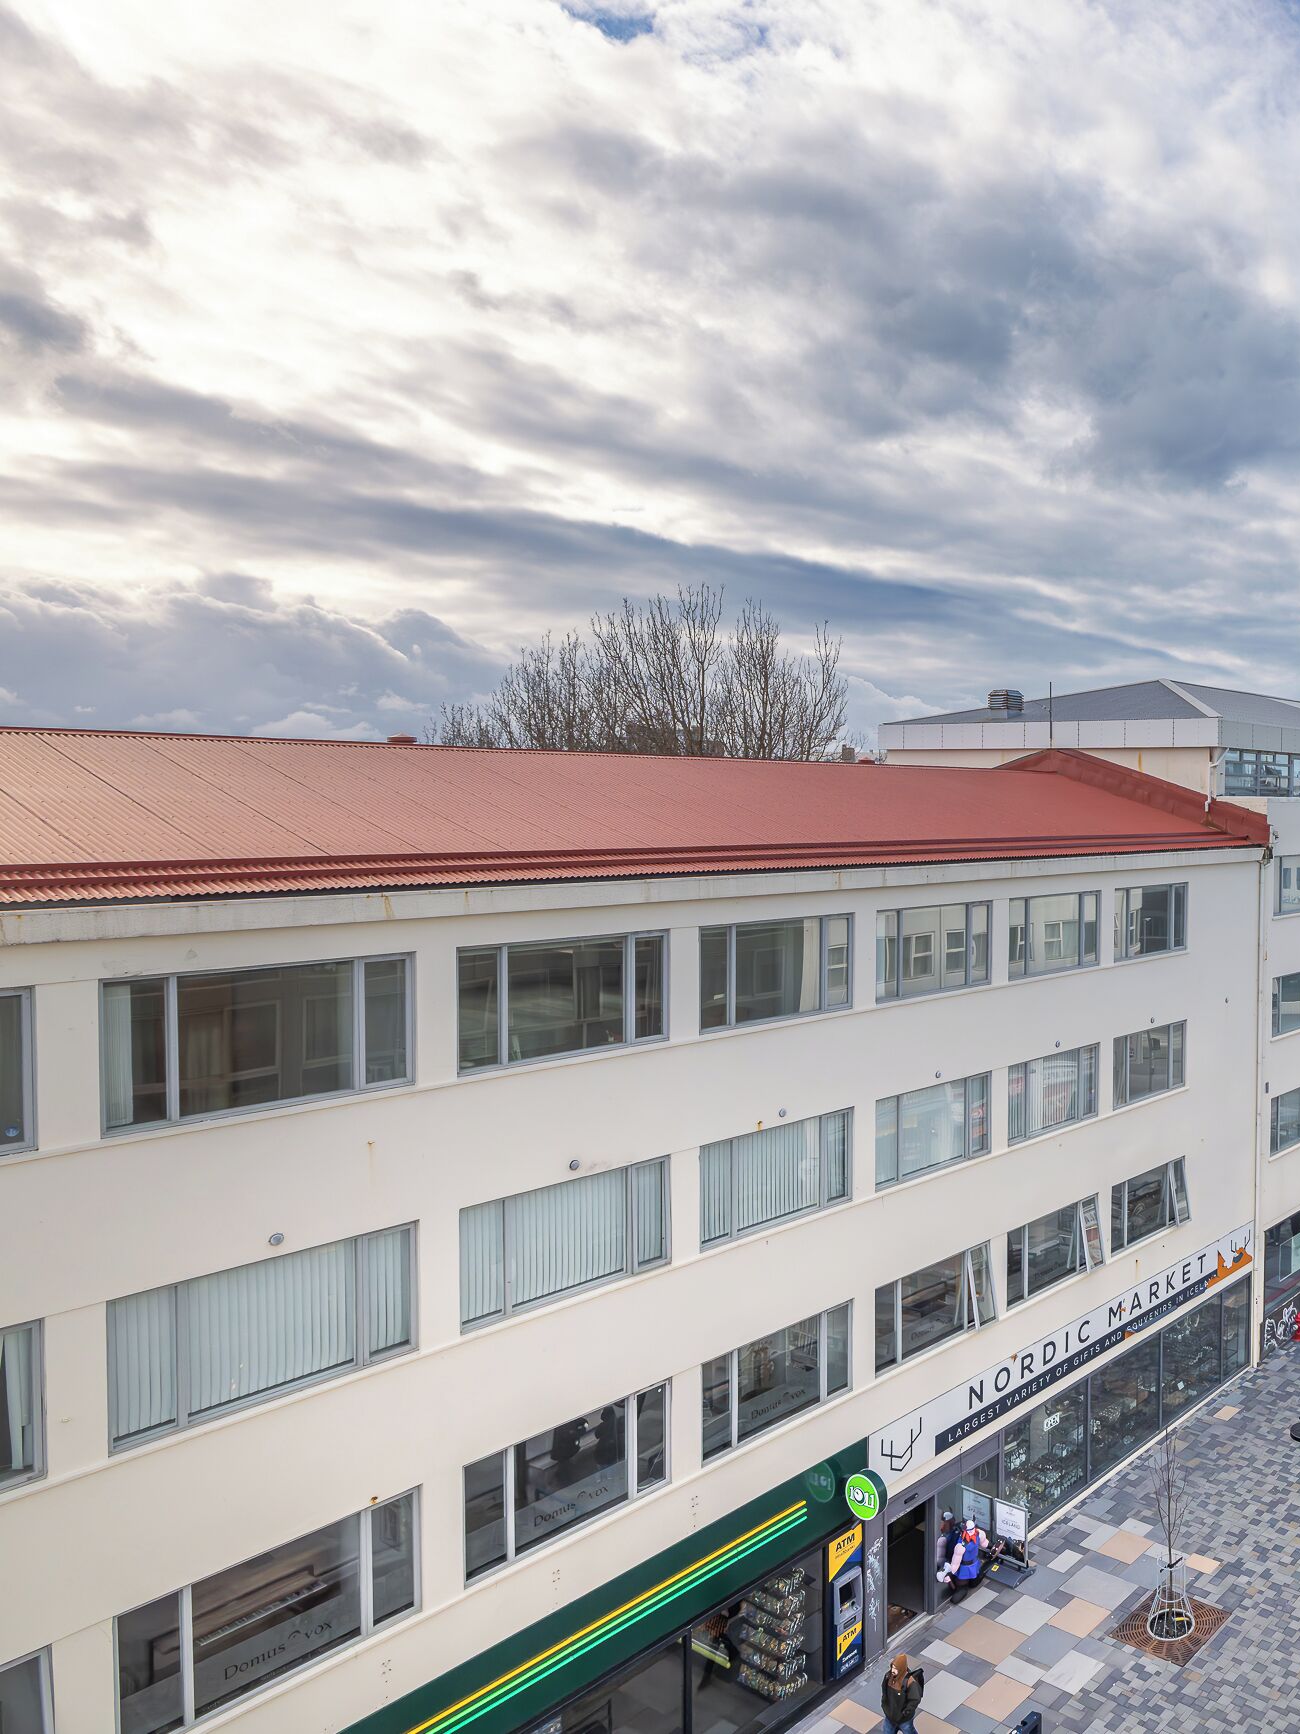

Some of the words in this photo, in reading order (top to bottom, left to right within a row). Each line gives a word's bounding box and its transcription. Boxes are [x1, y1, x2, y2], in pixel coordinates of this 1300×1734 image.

[968, 1320, 1090, 1410] NORDIC
[1108, 1253, 1207, 1328] MARKET
[948, 1404, 1000, 1442] LARGEST
[1006, 1374, 1051, 1406] VARIETY
[1055, 1363, 1068, 1377] OF
[1073, 1344, 1100, 1366] GIFTS
[1104, 1331, 1122, 1347] AND
[1126, 1301, 1172, 1332] SOUVENIRS
[1175, 1295, 1184, 1304] IN
[751, 1399, 782, 1419] Domus
[1045, 1413, 1059, 1430] OPEN
[534, 1503, 576, 1527] Domus
[588, 1486, 609, 1500] vox
[835, 1532, 855, 1552] ATM
[842, 1627, 857, 1642] ATM
[224, 1643, 286, 1680] Domus
[304, 1621, 333, 1640] vox
